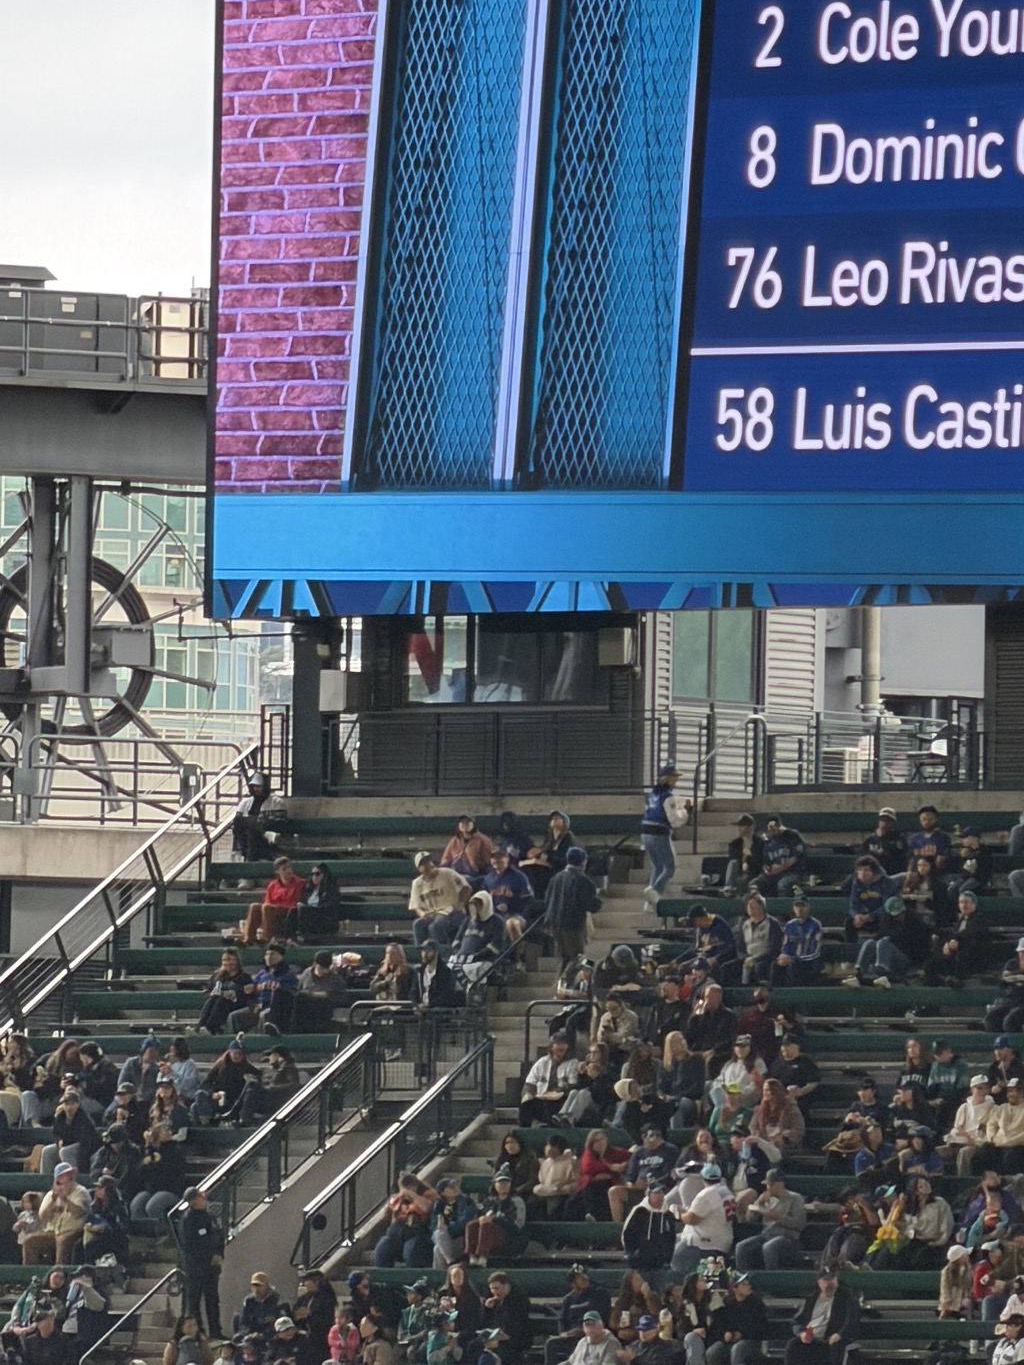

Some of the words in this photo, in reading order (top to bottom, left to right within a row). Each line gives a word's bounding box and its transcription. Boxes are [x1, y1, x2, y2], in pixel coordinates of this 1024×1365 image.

[754, 4, 786, 69] 2
[746, 124, 778, 190] 8
[810, 115, 1006, 186] Dominic
[727, 245, 784, 310] 76
[802, 244, 890, 308] Leo
[715, 386, 775, 453] 58
[792, 385, 893, 452] Luis
